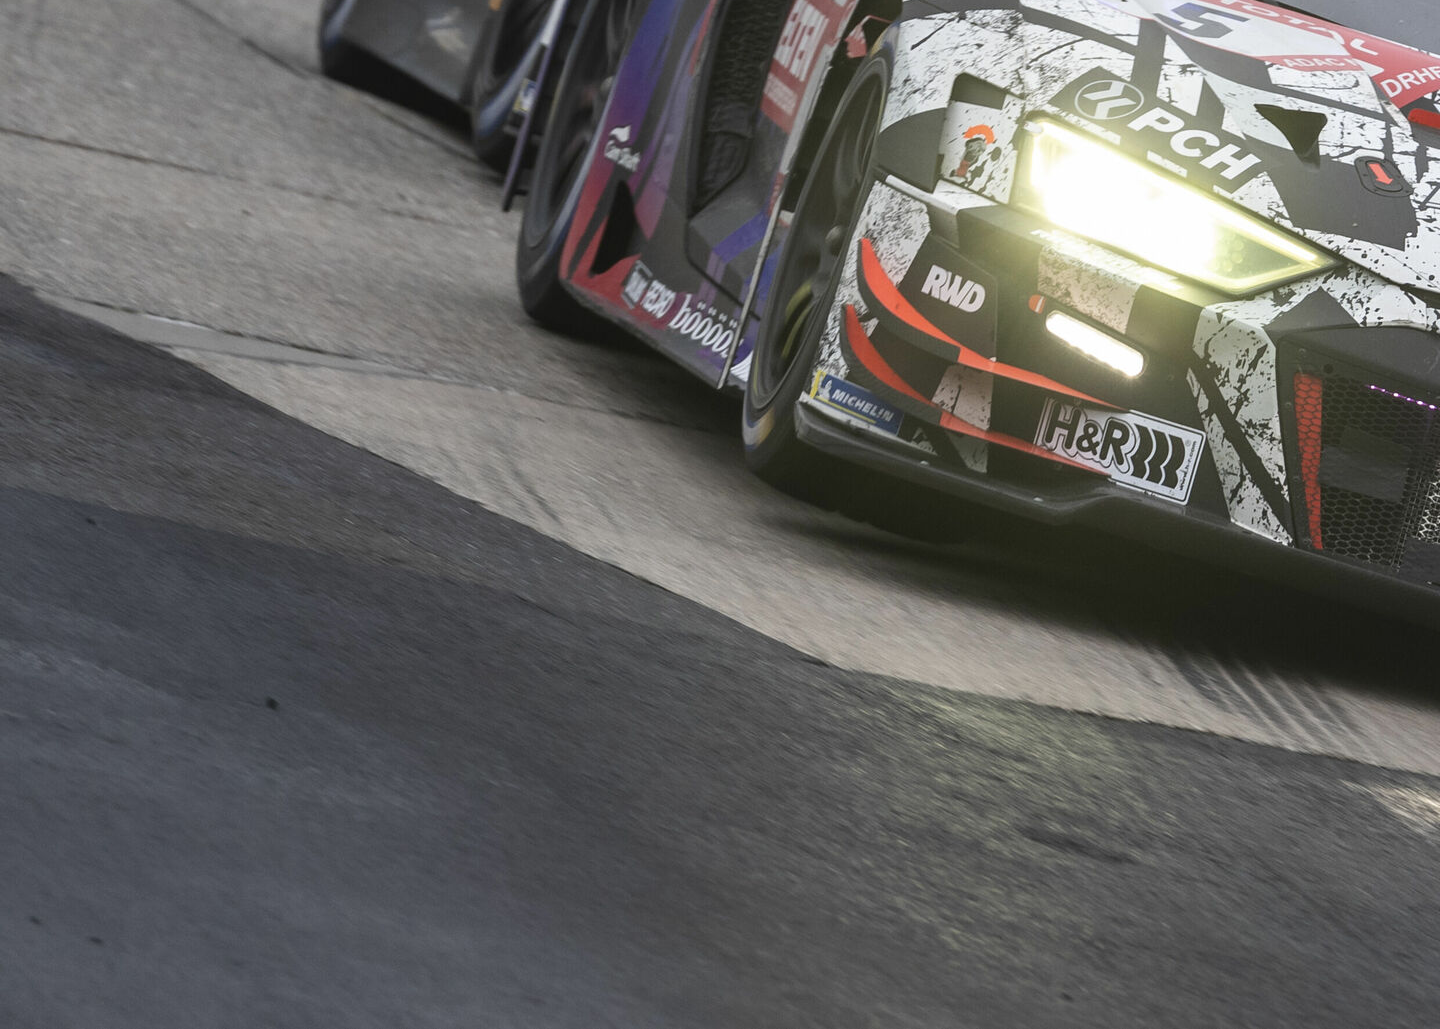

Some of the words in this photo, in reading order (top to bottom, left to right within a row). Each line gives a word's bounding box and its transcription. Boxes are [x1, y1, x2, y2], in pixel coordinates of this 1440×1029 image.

[1152, 2, 1250, 39] 5
[1283, 57, 1345, 69] ADAC
[1127, 106, 1263, 181] PCH
[921, 264, 986, 313] RWD
[831, 388, 895, 423] MICHELIN
[1043, 401, 1133, 469] H&R
